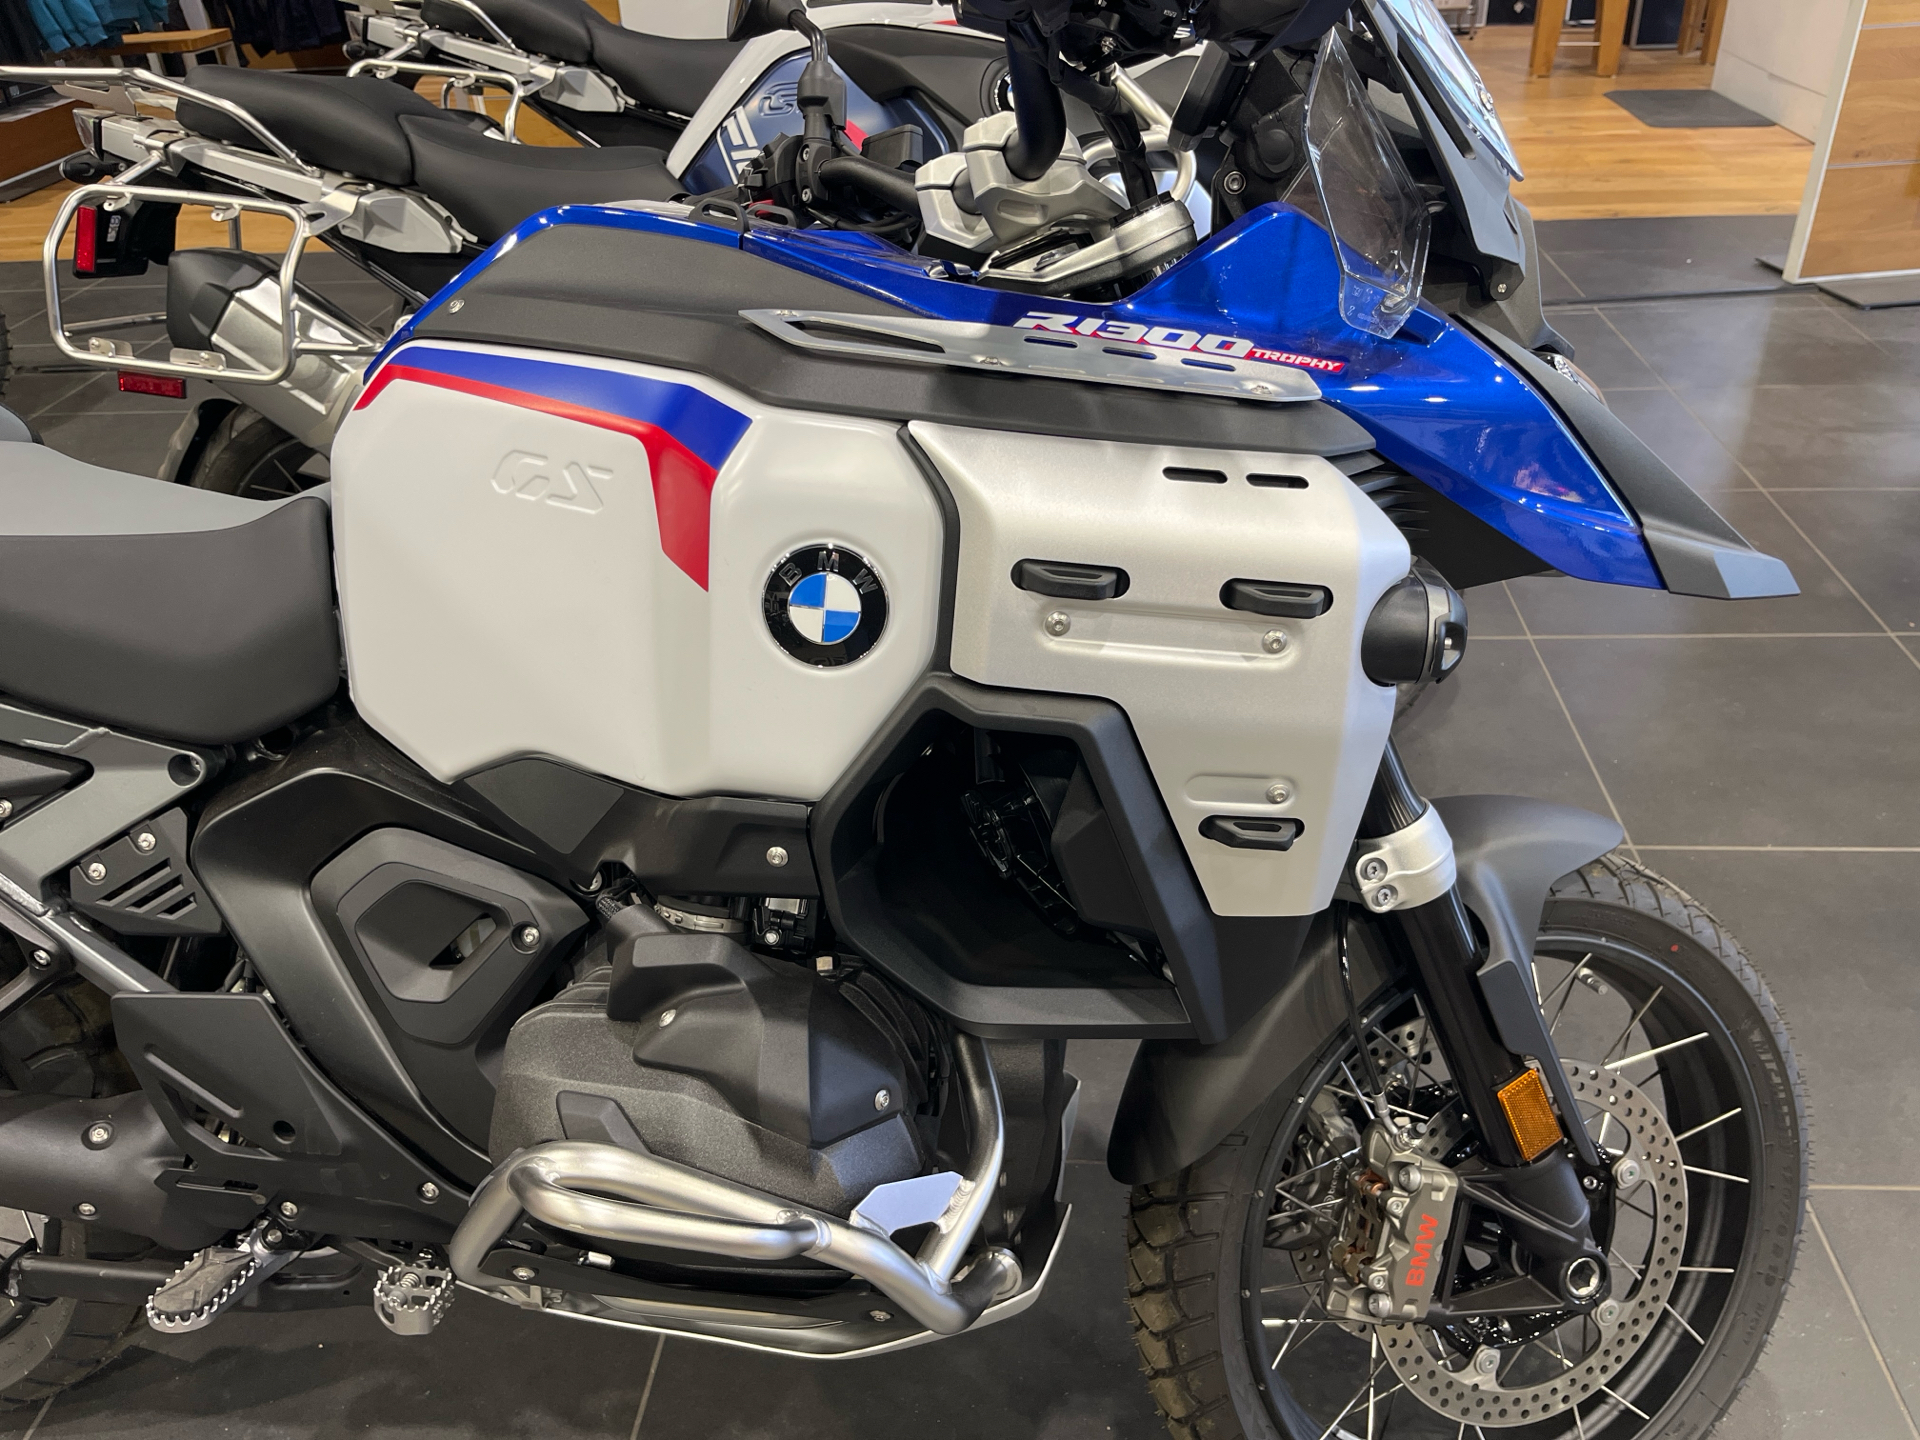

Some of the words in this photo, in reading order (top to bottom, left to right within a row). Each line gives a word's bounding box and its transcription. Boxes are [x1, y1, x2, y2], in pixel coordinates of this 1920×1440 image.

[1251, 348, 1344, 372] TROPHY
[490, 449, 613, 514] GS
[778, 550, 878, 596] BMW
[1405, 1213, 1439, 1287] BMW
